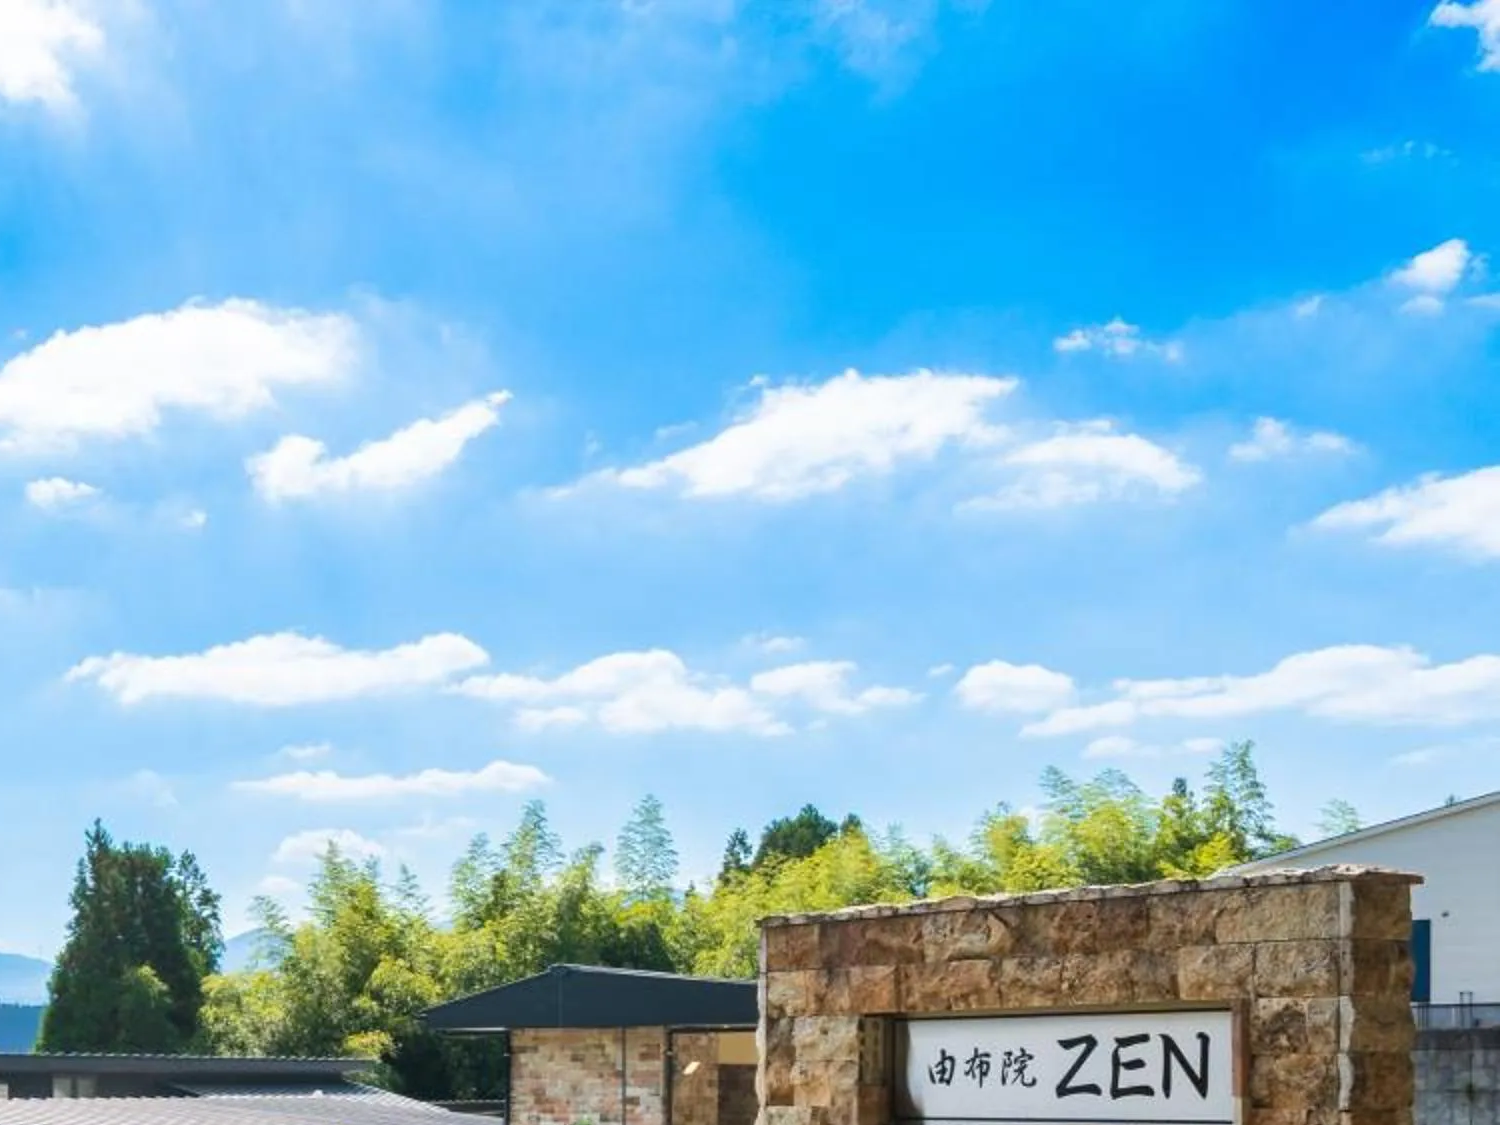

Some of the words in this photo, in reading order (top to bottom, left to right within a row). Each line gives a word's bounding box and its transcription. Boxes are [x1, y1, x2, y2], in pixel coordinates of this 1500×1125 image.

[928, 1046, 1038, 1088] 由布院
[1055, 1031, 1211, 1100] ZEN
